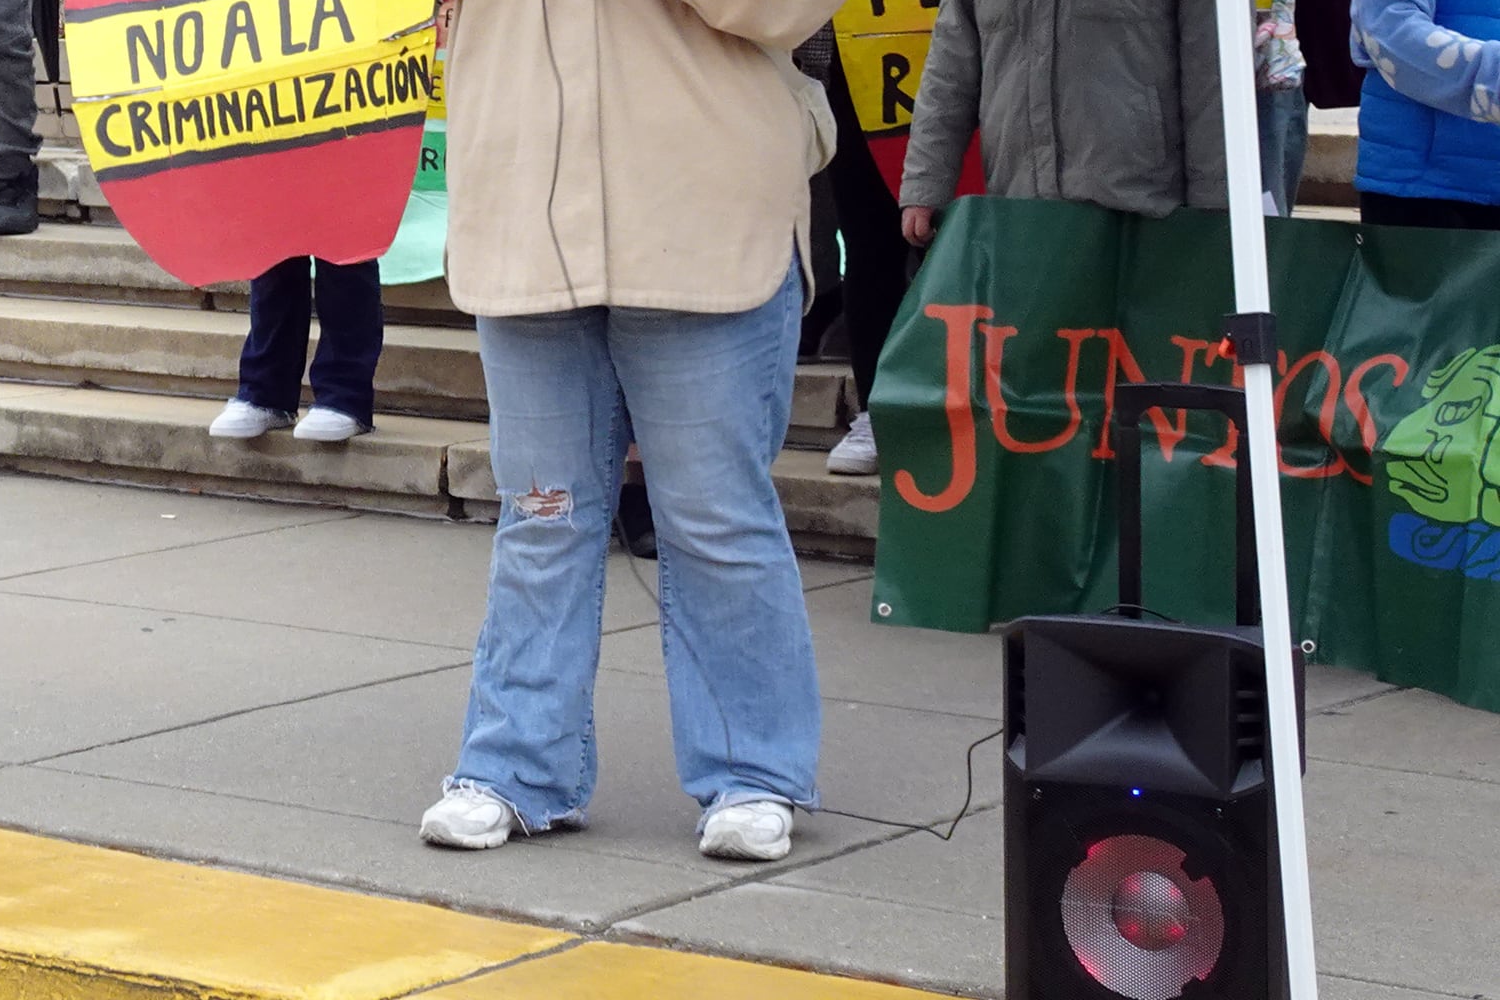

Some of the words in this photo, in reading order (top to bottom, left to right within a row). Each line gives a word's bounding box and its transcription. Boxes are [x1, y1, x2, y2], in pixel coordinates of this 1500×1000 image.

[126, 11, 204, 84] NO
[221, 1, 262, 69] A
[96, 47, 431, 158] CRIMINALIZACIÓN
